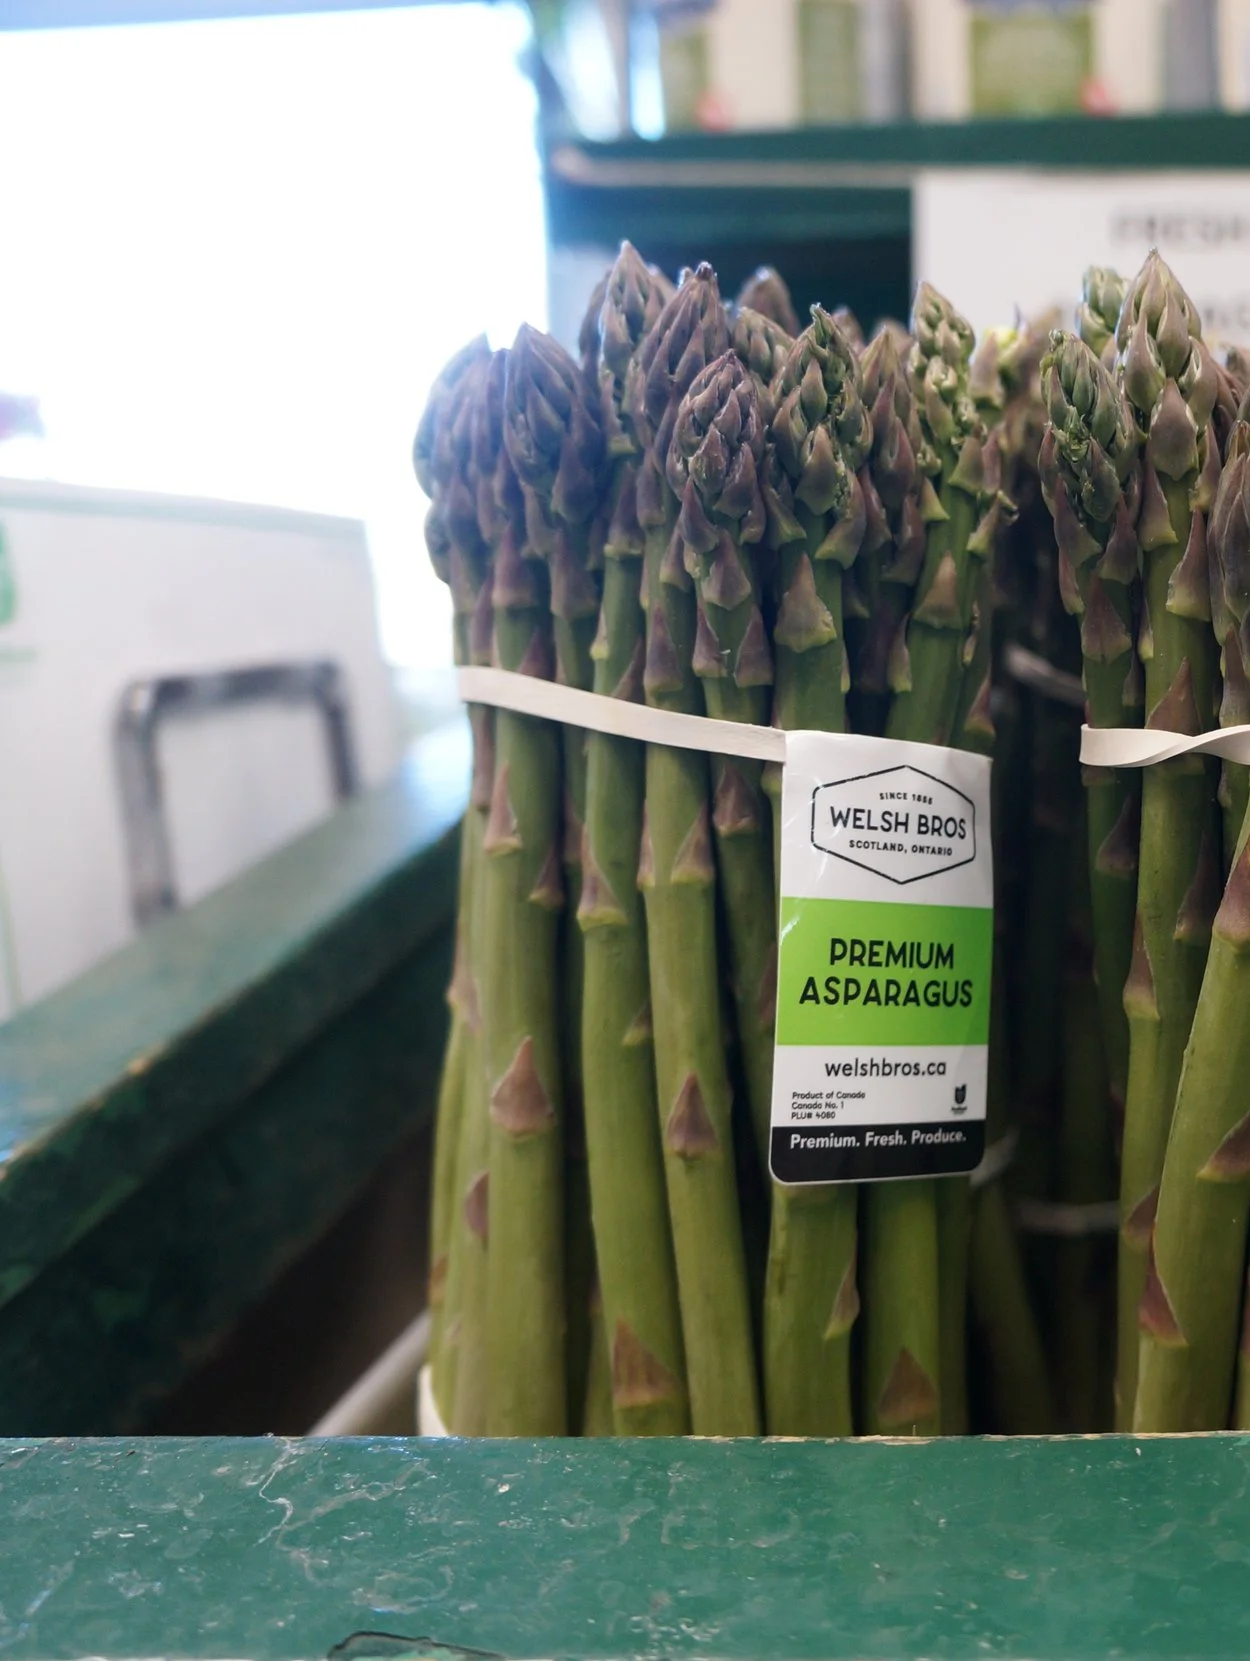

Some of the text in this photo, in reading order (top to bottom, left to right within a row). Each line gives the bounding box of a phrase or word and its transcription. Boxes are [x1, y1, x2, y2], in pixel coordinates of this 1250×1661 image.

[879, 792, 908, 801] SINCE
[830, 806, 967, 840] WELSH BROS
[849, 839, 953, 857] SCOTLAND, ONTARIO
[829, 937, 954, 970] PREMIUM
[798, 976, 974, 1008] ASPARAGUS
[825, 1057, 947, 1077] welshbros.ca
[792, 1091, 866, 1100] Product of Canada
[791, 1101, 823, 1110] Canada
[824, 1101, 839, 1110] No.
[791, 1111, 836, 1120] PLU# 4080
[789, 1127, 967, 1150] Premium. Fresh. Produce.
